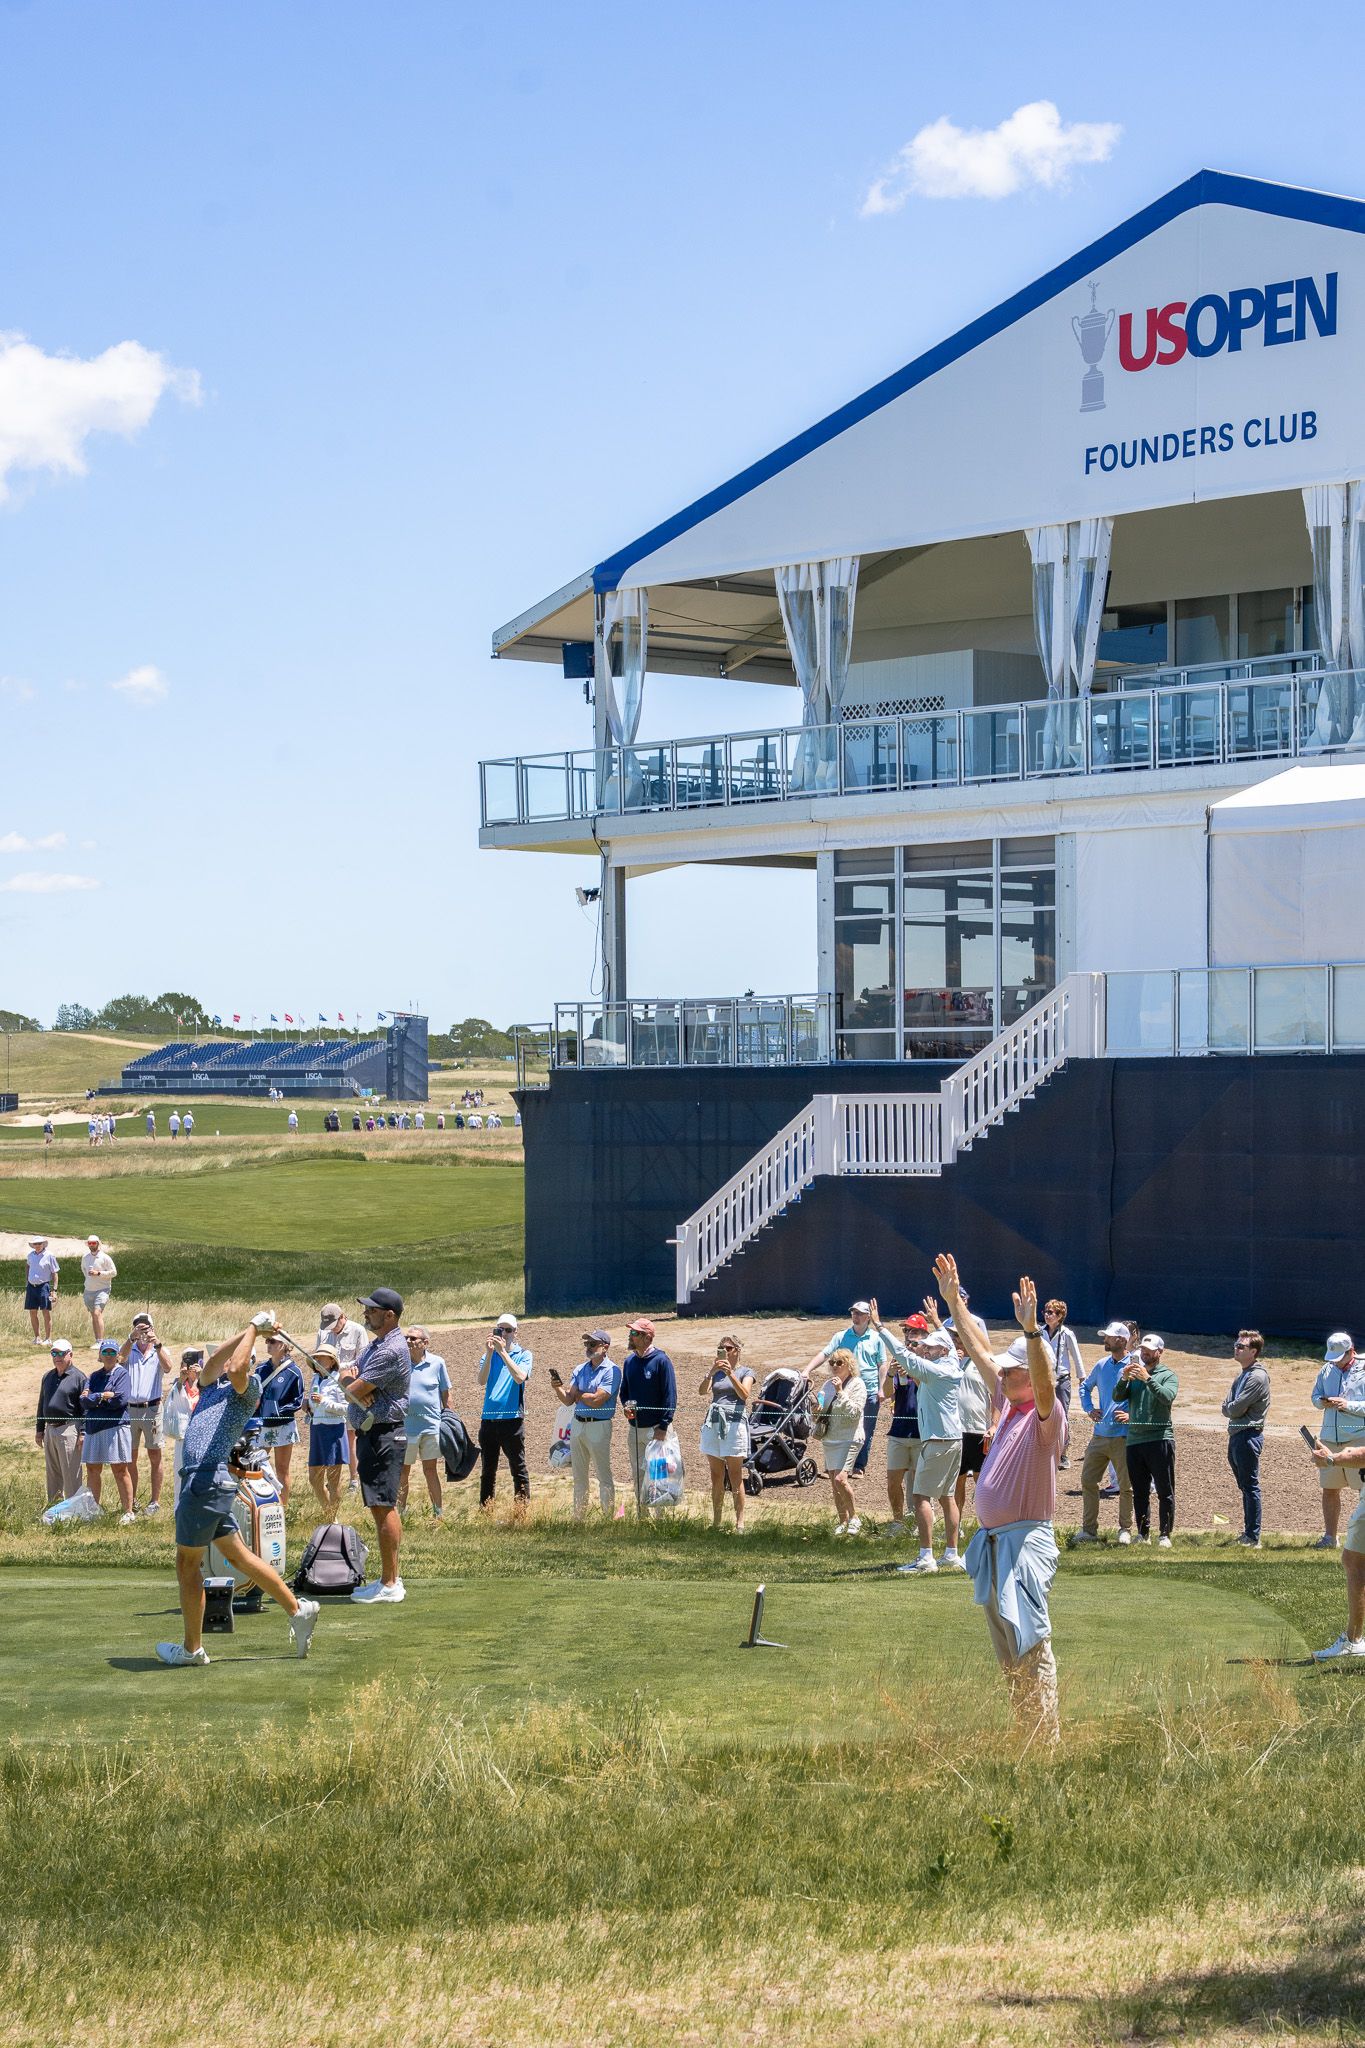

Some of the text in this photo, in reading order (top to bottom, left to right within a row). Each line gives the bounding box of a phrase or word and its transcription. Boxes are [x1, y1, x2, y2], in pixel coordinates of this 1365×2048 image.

[1084, 410, 1318, 475] FOUNDERS CLUB
[305, 1072, 323, 1080] USGA
